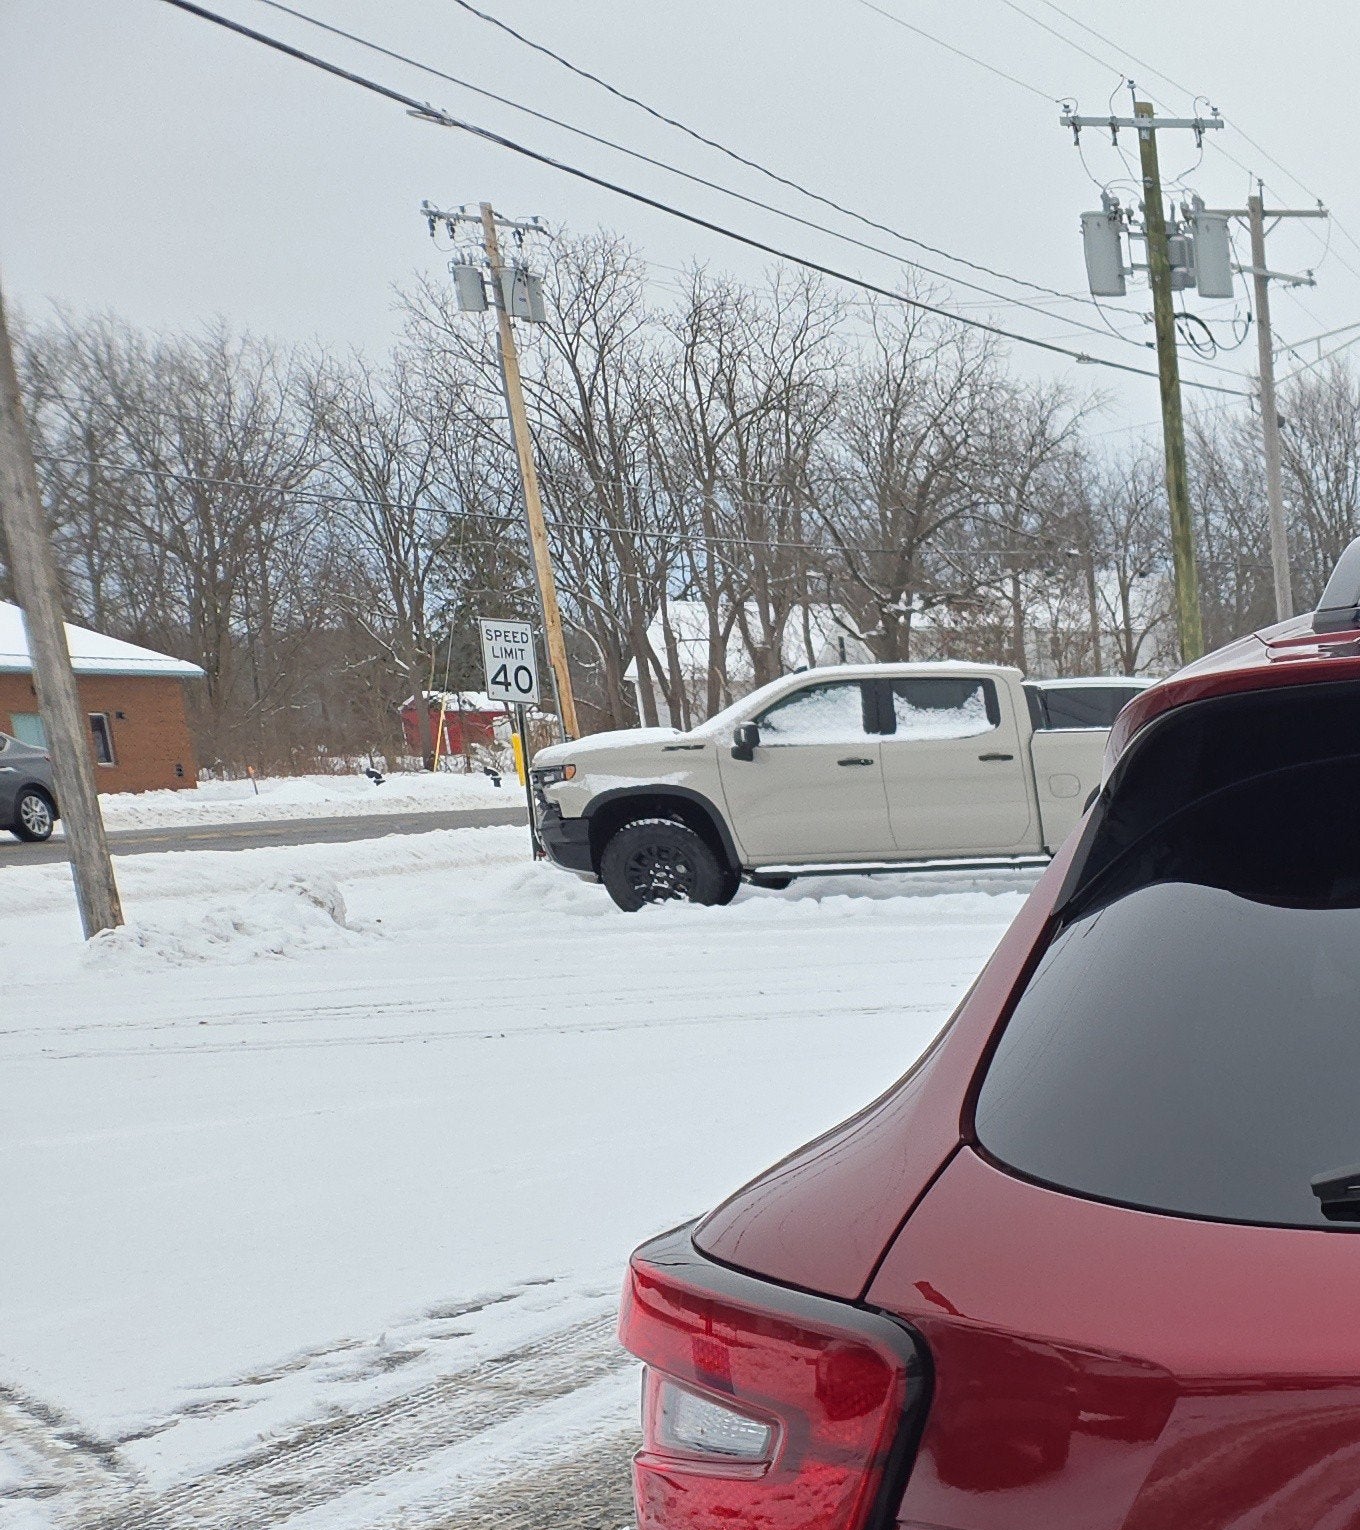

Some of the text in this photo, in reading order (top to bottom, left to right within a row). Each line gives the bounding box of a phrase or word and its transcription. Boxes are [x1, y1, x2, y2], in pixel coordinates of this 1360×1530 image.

[486, 629, 528, 644] SPEED
[492, 646, 525, 660] LIMIT
[491, 664, 533, 693] 40
